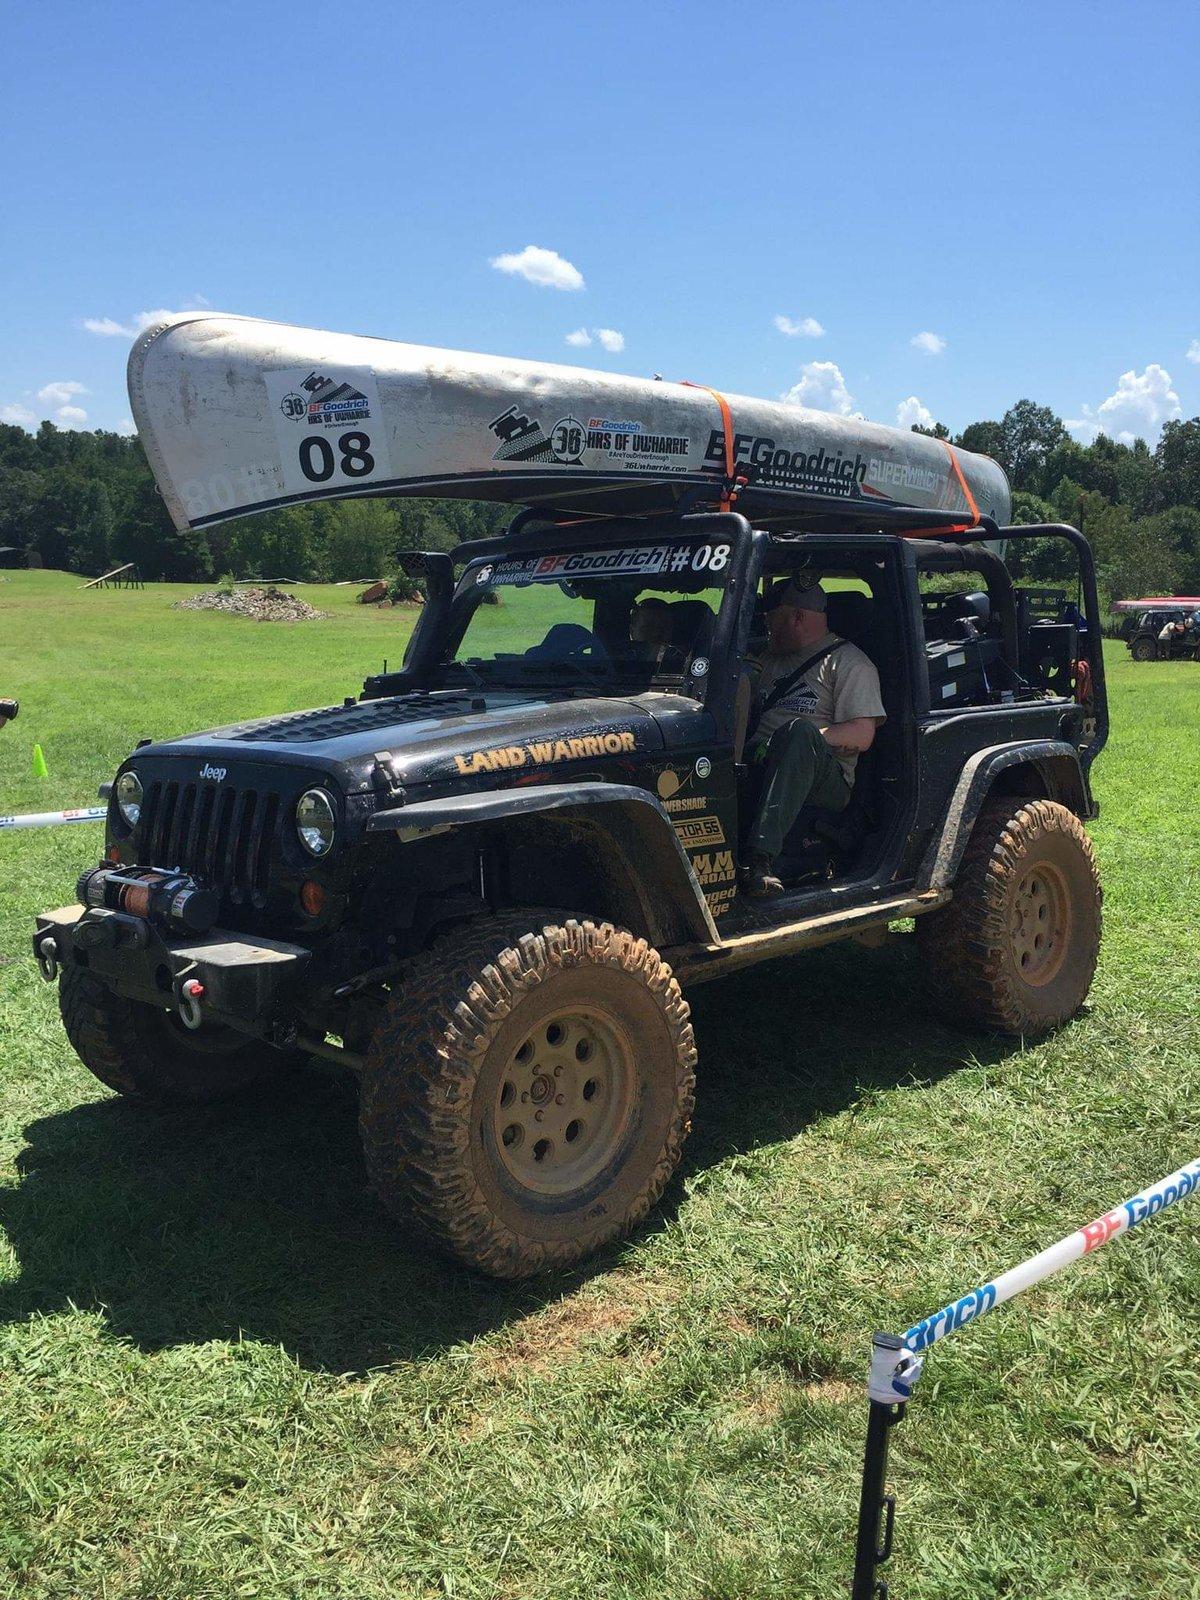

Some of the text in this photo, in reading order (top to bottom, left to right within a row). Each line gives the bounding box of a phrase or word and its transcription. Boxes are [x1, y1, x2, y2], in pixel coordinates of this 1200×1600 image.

[308, 399, 369, 413] BFGoodrich
[588, 418, 641, 432] BFGoodrich
[587, 431, 689, 456] HRS OF UWHARRIE
[299, 431, 375, 482] 08
[702, 429, 867, 484] BFGoodrich
[496, 560, 525, 572] HOURS
[536, 547, 663, 575] BFGoodrich
[670, 544, 731, 572] #08
[454, 732, 636, 775] LAND WARRIOR
[200, 763, 227, 782] Jeep
[704, 820, 719, 834] 55
